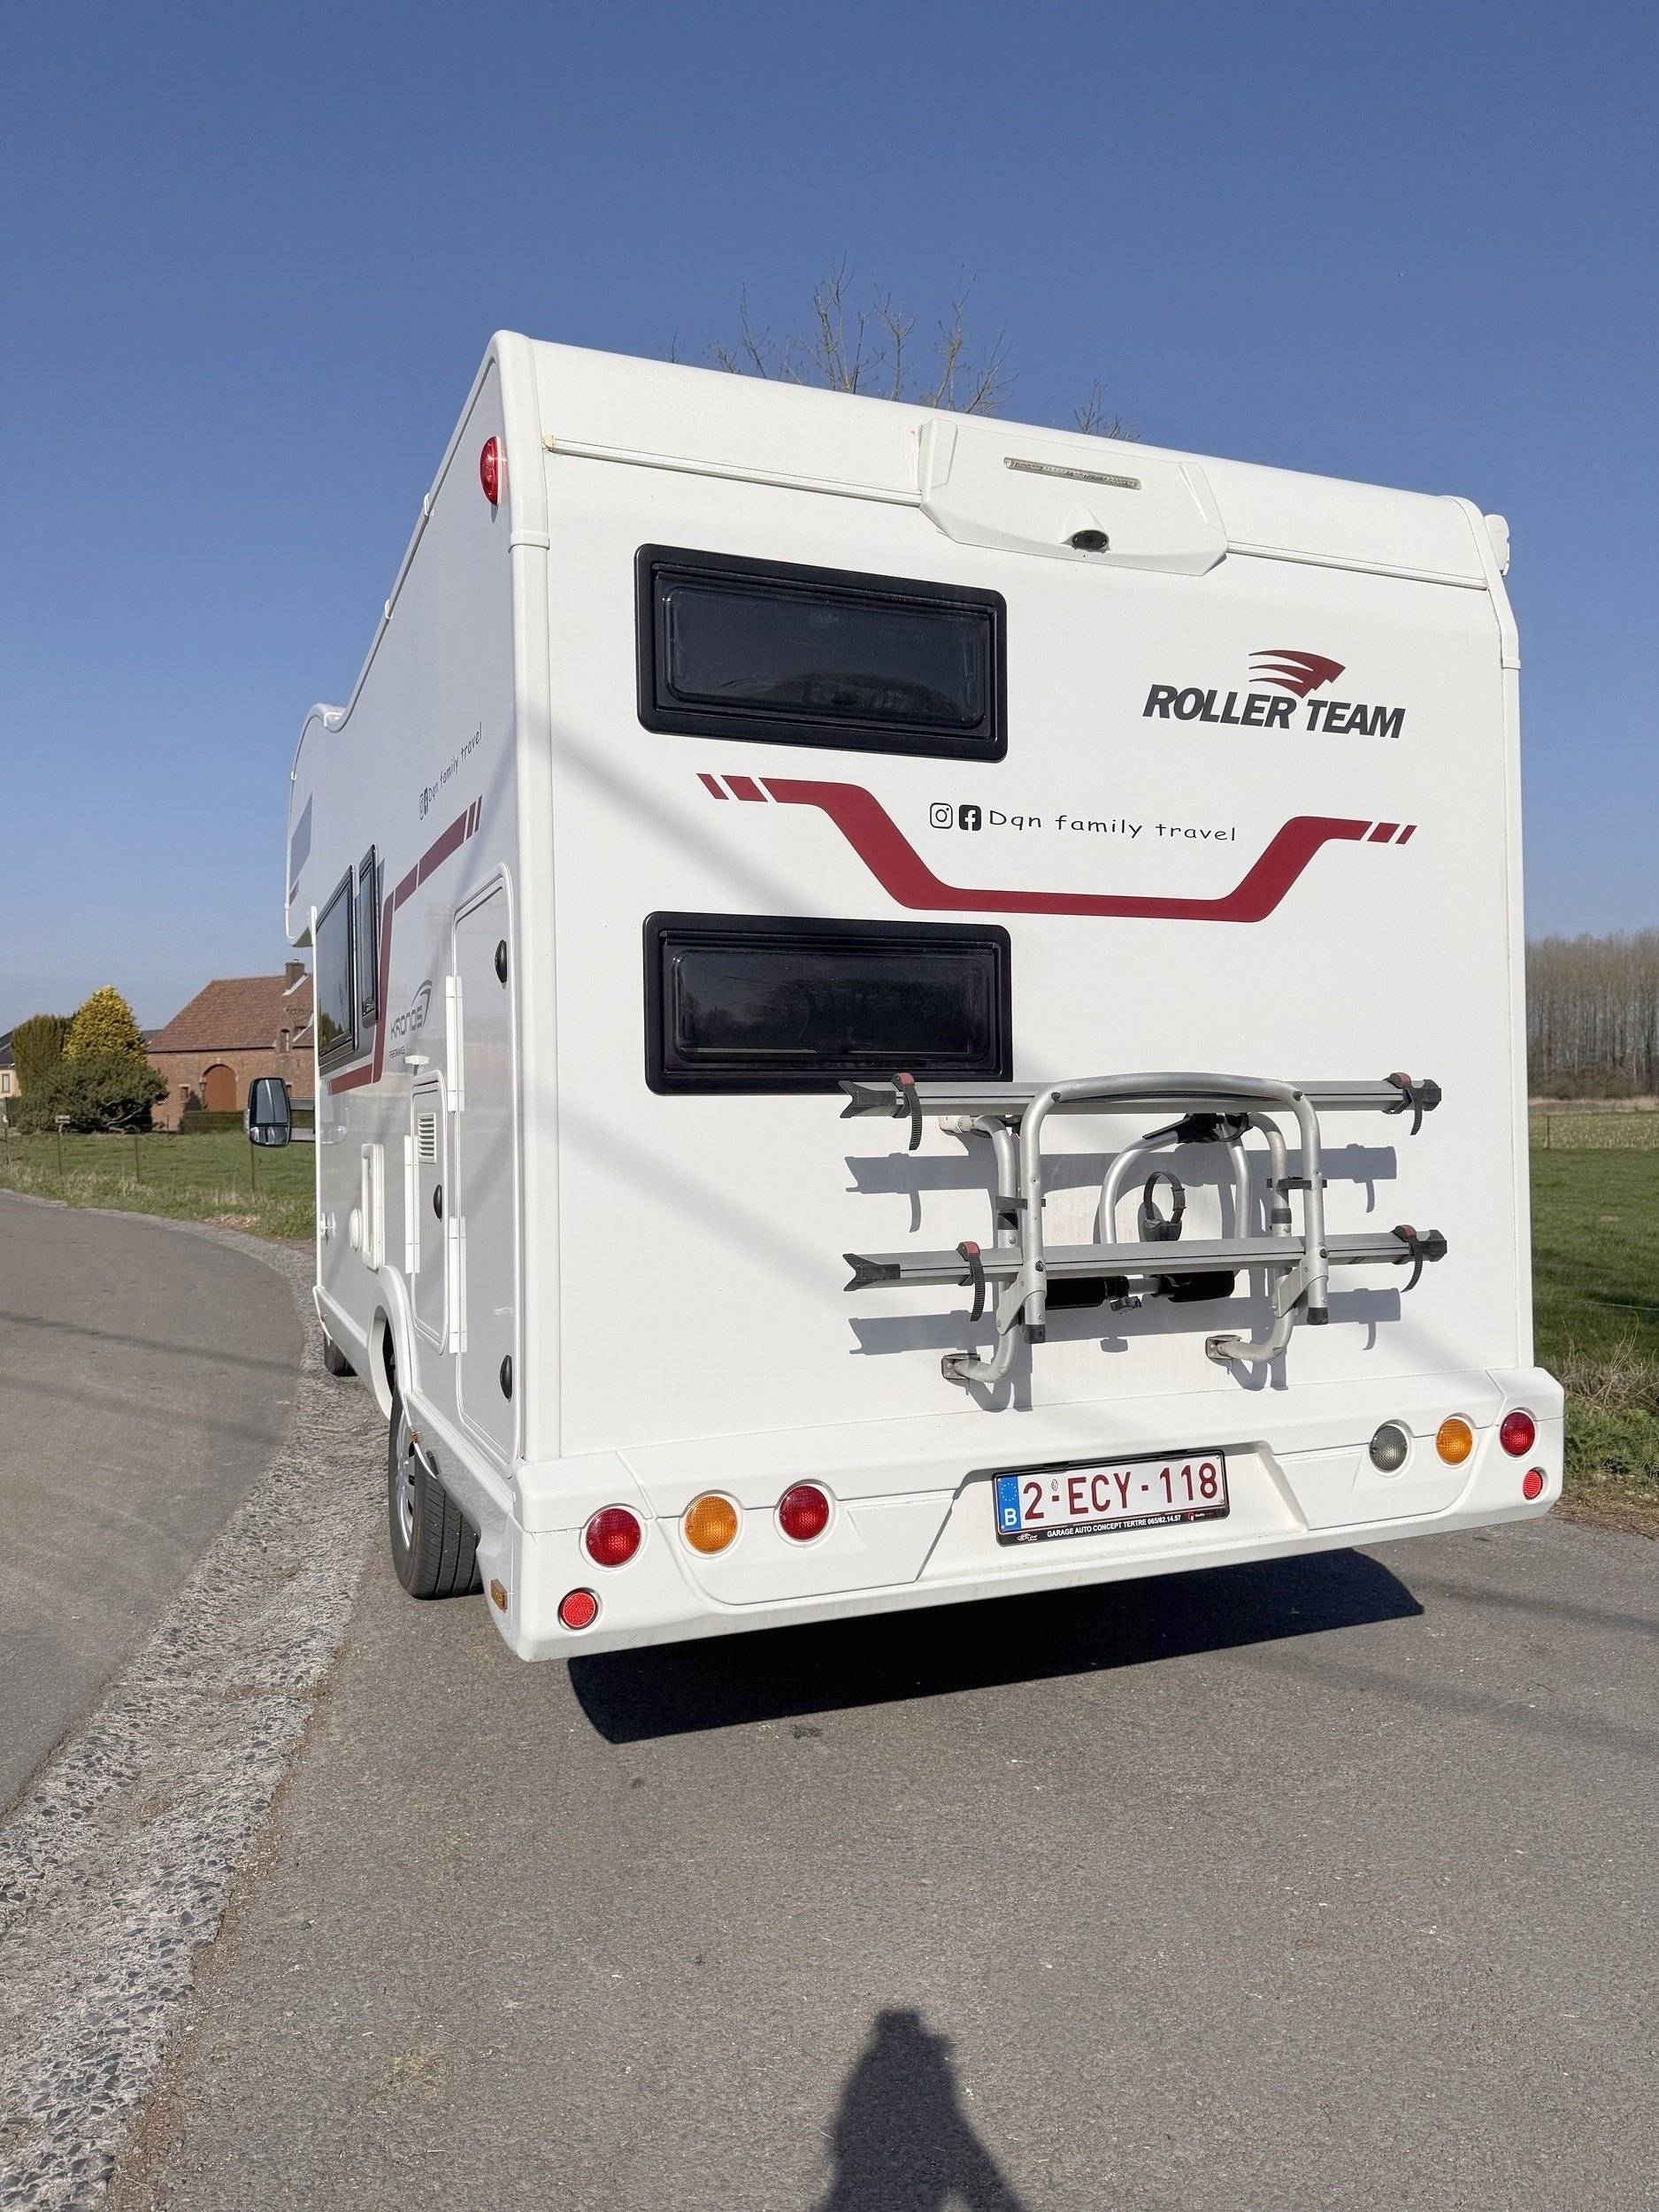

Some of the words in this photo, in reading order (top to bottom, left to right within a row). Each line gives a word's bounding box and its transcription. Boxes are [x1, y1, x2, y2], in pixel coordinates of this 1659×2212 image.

[1142, 684, 1297, 729] ROLLER
[1306, 698, 1406, 738] TEAM
[460, 721, 482, 762] travel
[989, 810, 1042, 831] Dqn
[1055, 815, 1142, 839] family
[1155, 823, 1236, 841] travel
[390, 1005, 423, 1041] KRONOS
[1003, 1508, 1018, 1526] B
[1047, 1528, 1073, 1537] GARAGE
[1074, 1525, 1093, 1534] AUTO
[1092, 1521, 1123, 1532] CONCEPT
[1123, 1518, 1148, 1528] TERTRE
